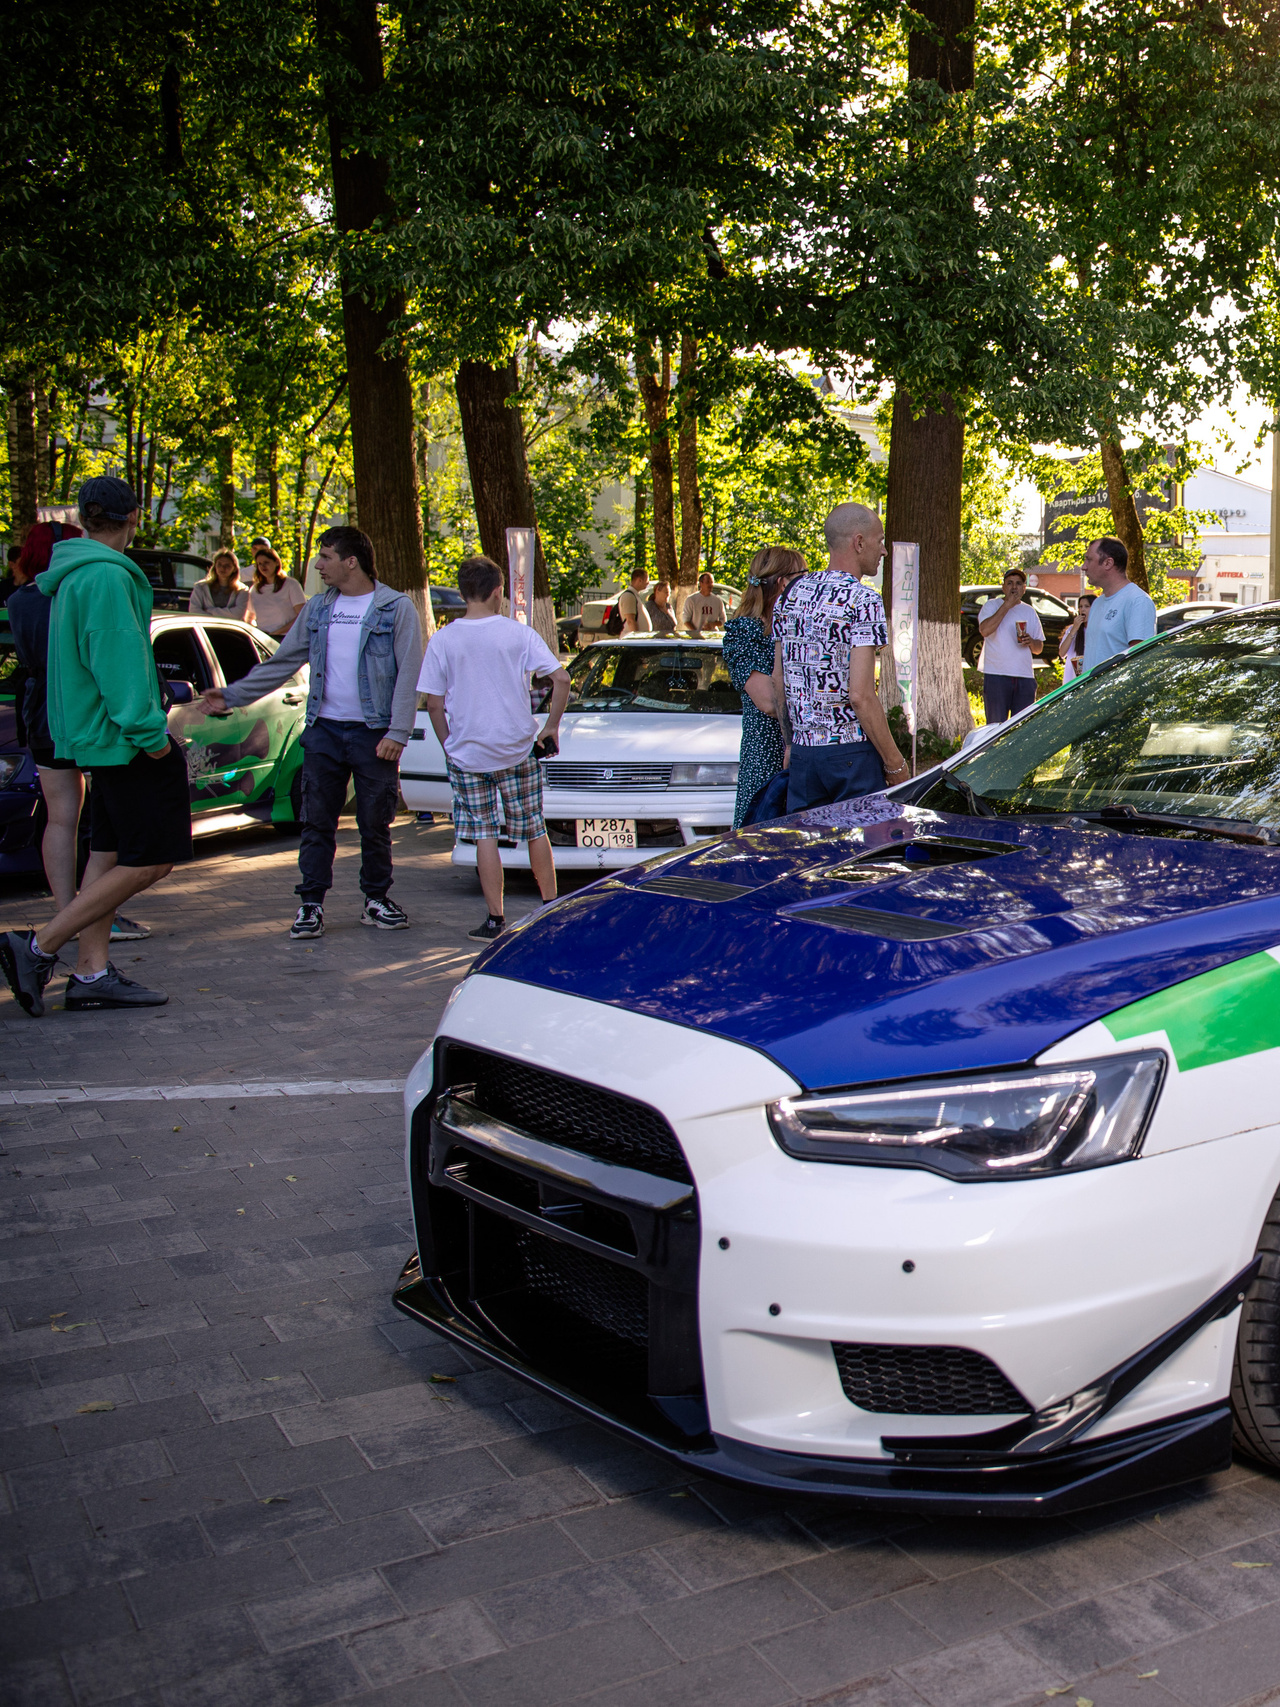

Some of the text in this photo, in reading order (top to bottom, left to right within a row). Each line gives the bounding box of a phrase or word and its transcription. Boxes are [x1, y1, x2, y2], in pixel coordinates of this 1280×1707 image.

[1216, 571, 1244, 579] АПТЕКА
[600, 819, 627, 832] 287
[612, 834, 634, 845] 198
